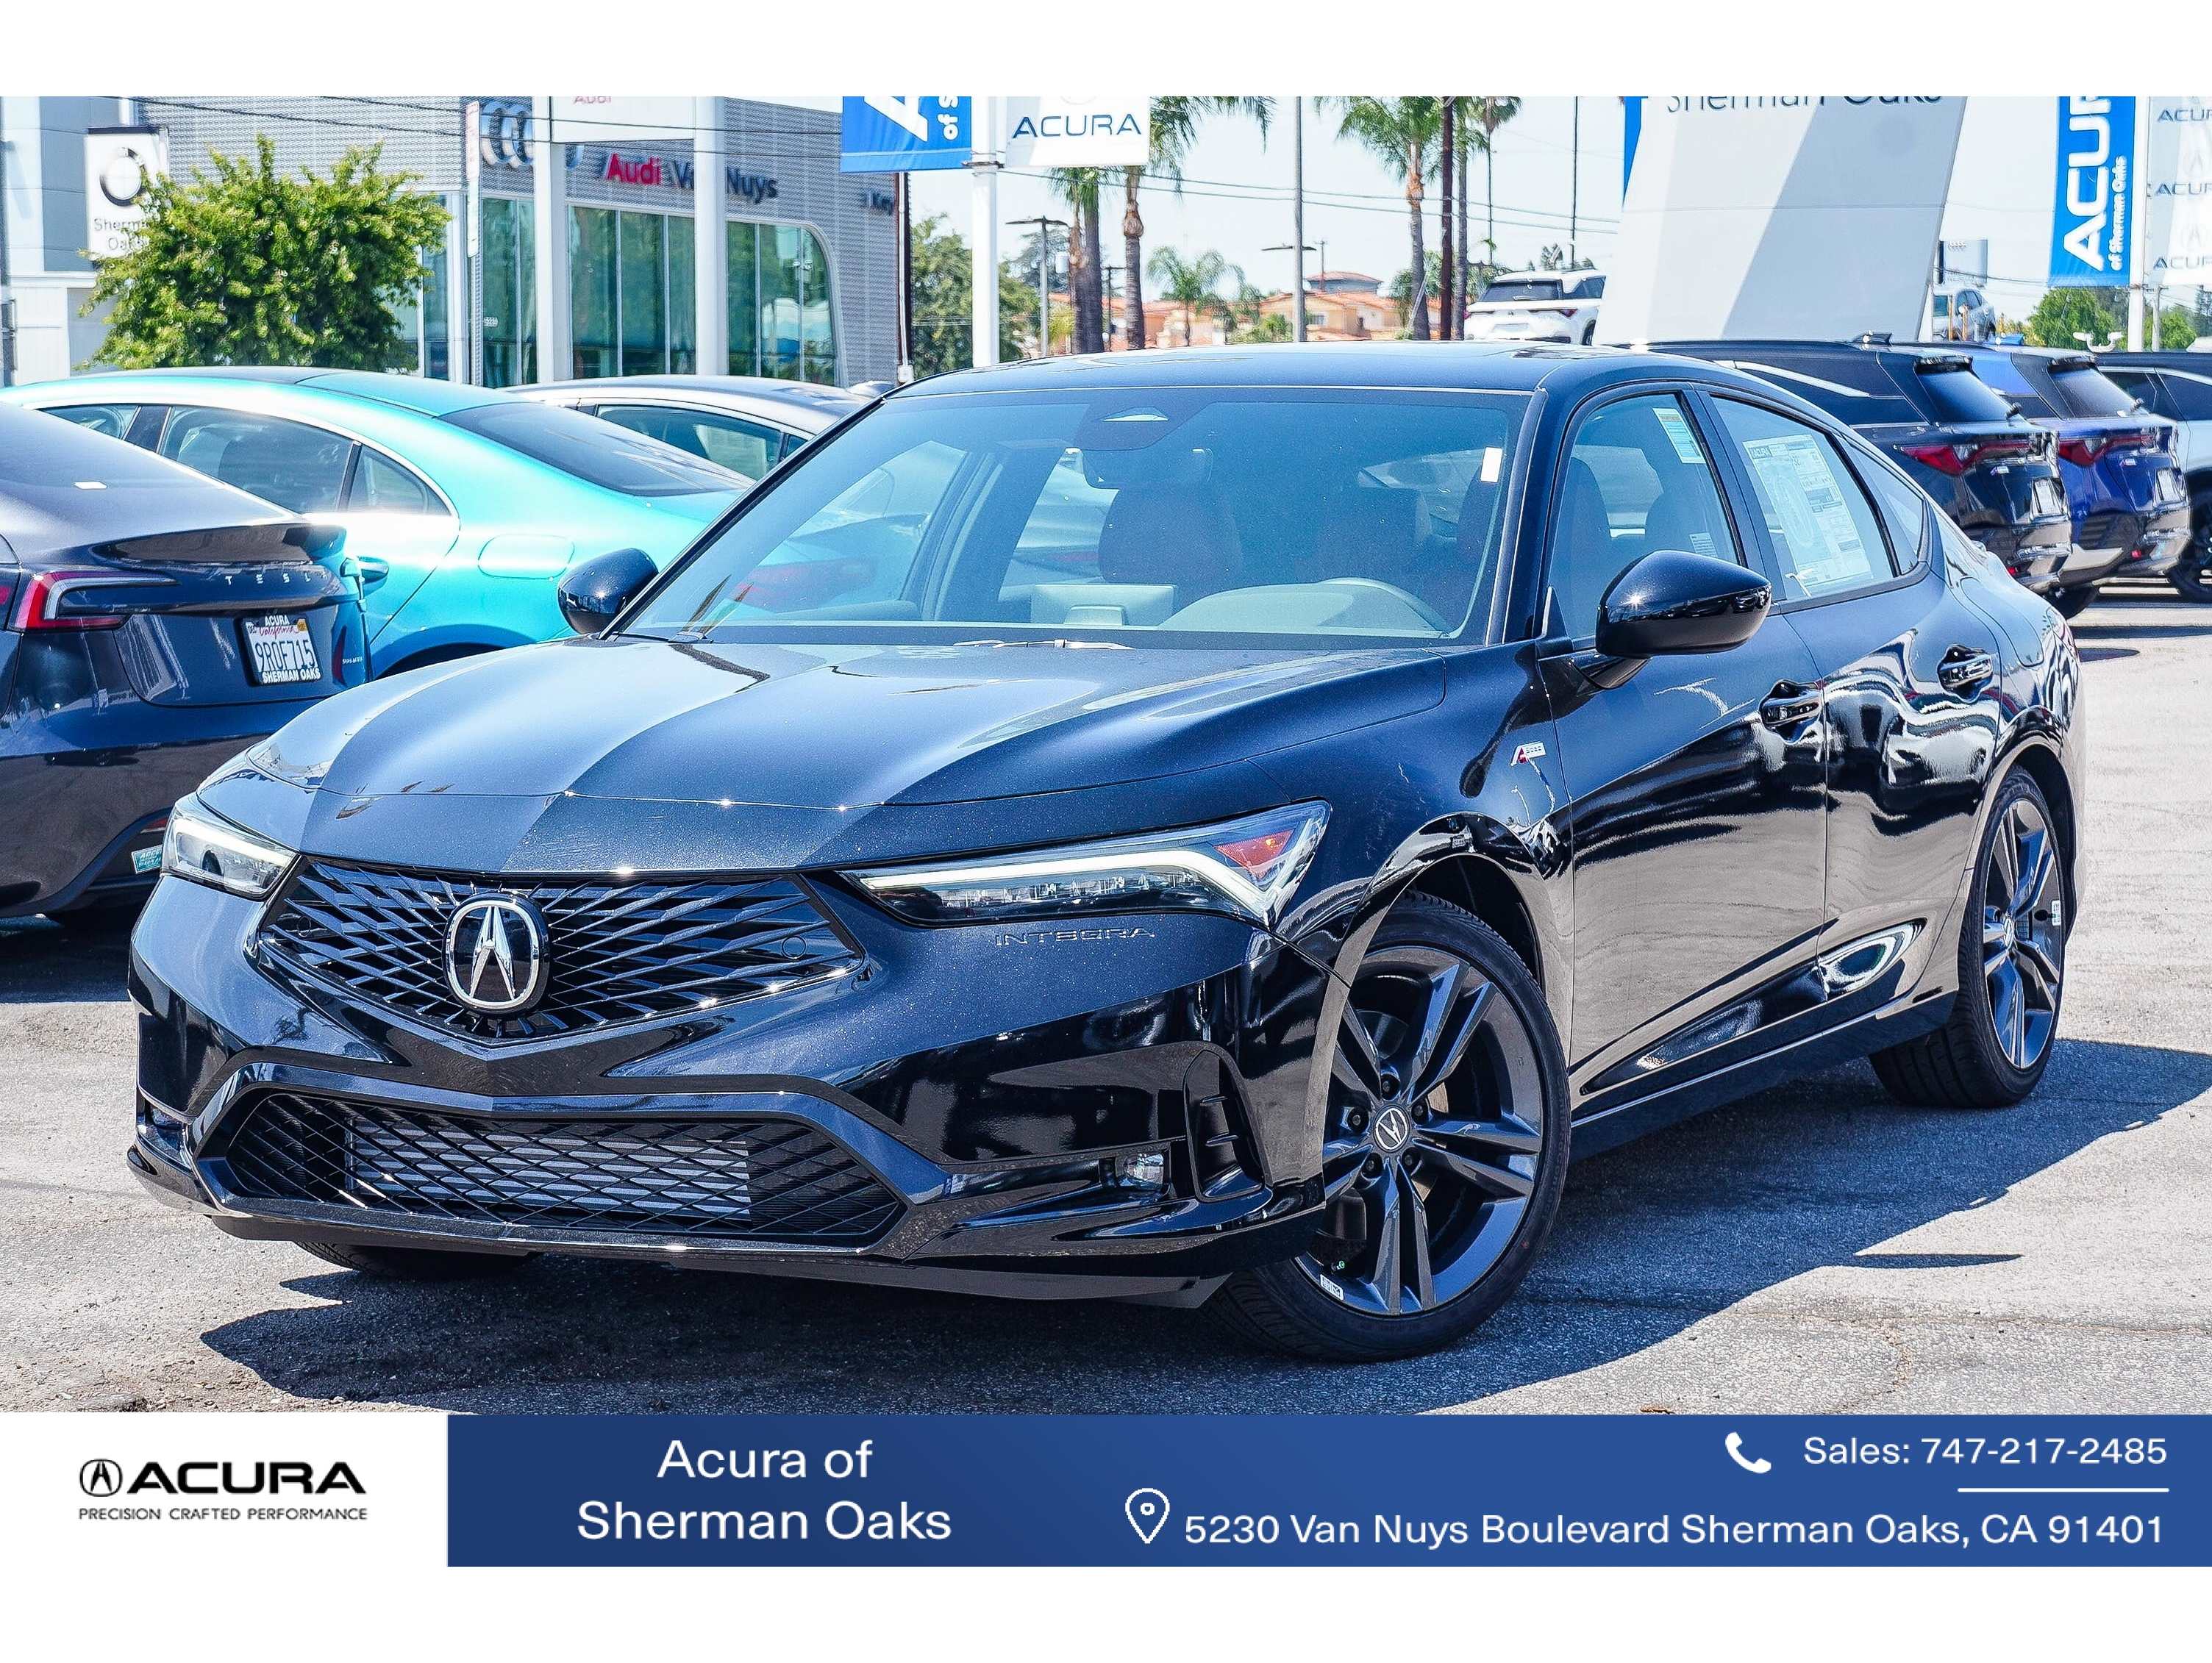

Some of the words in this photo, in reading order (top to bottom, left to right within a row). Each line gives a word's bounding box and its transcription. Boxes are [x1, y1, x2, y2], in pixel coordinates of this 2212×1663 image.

[1012, 113, 1142, 139] ACURA
[605, 153, 661, 185] Audi
[726, 165, 777, 204] Nuys
[265, 615, 290, 627] ACURA
[262, 669, 299, 684] SHERMAN
[300, 668, 321, 680] OAKS
[995, 927, 1155, 946] INTEGRA
